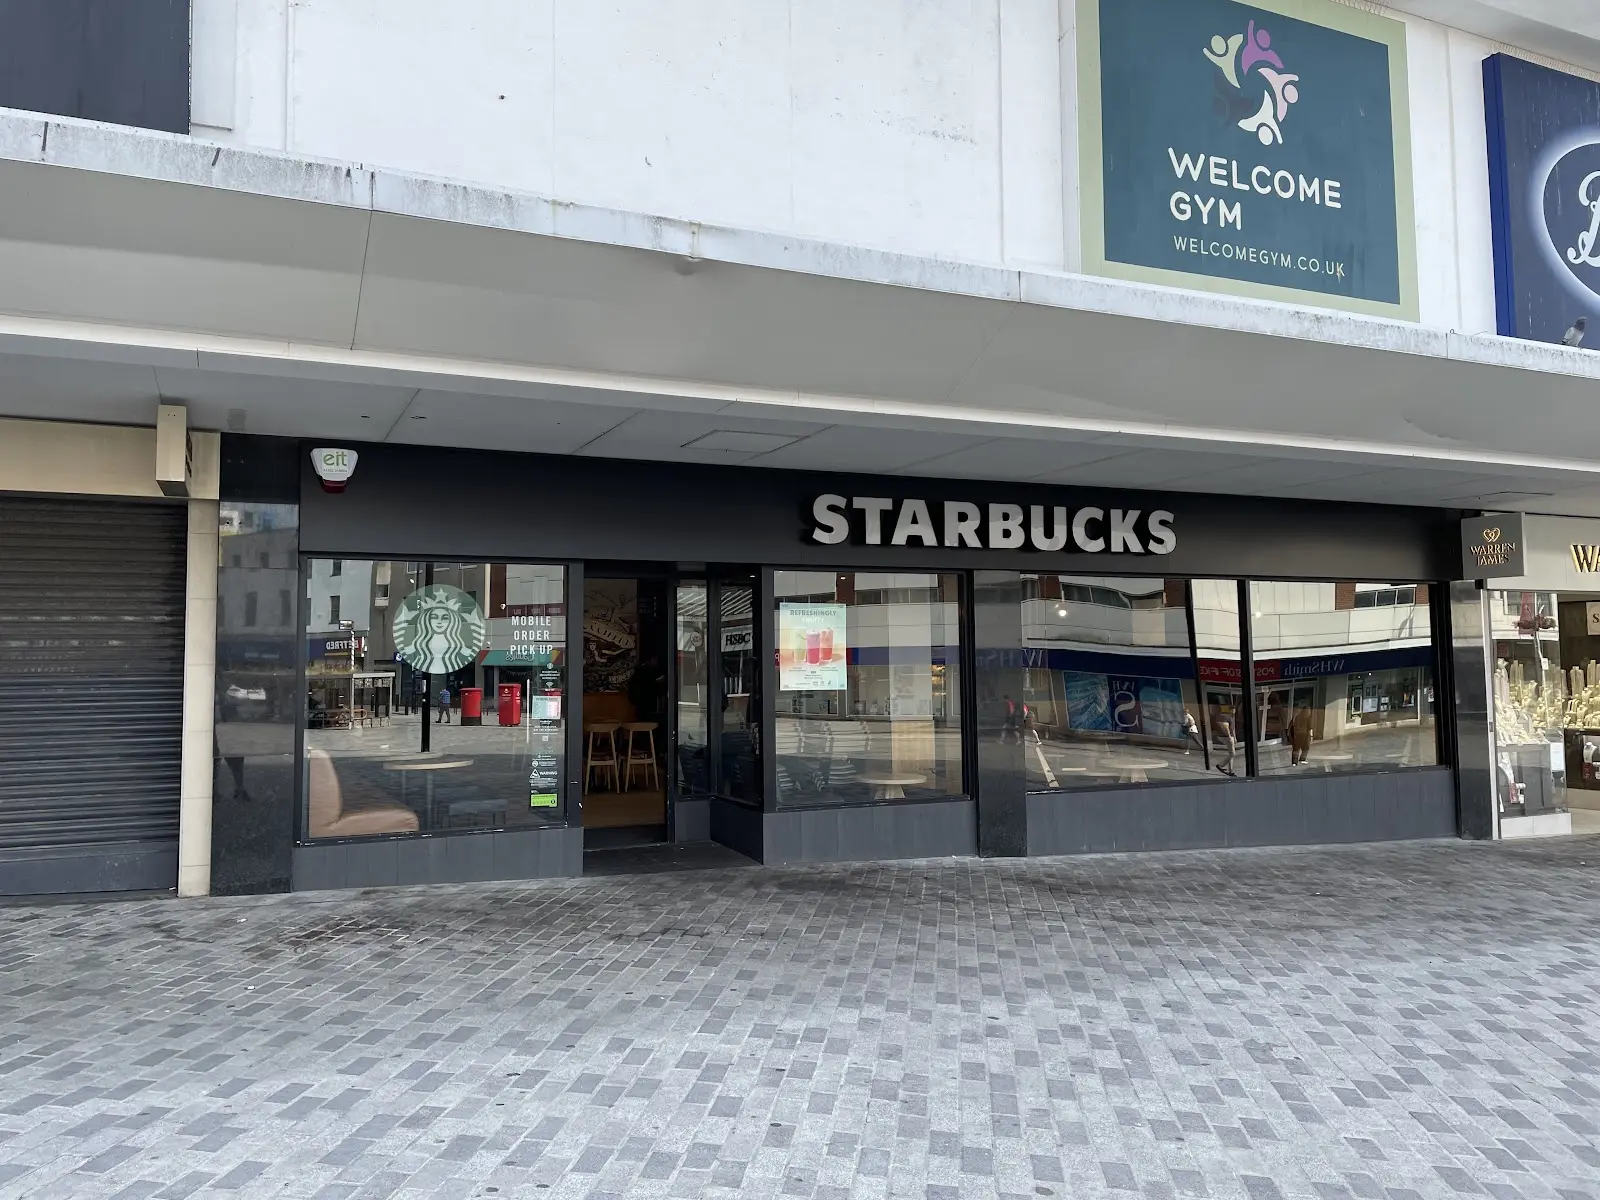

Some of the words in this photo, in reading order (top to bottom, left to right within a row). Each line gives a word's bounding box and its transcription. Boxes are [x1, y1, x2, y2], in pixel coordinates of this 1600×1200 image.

[1168, 147, 1342, 209] WELCOME
[1169, 191, 1242, 231] GYM
[1173, 235, 1346, 277] WELCOMEGYM.CO.UK
[322, 451, 348, 467] eit
[811, 493, 1178, 555] STARBUCKS
[1469, 542, 1516, 555] WARREN
[1475, 554, 1511, 567] JAMES
[511, 615, 552, 627] MOBILE
[513, 629, 550, 641] ORDER
[726, 632, 751, 646] HSBC
[510, 644, 535, 655] PICK
[540, 644, 554, 655] UP
